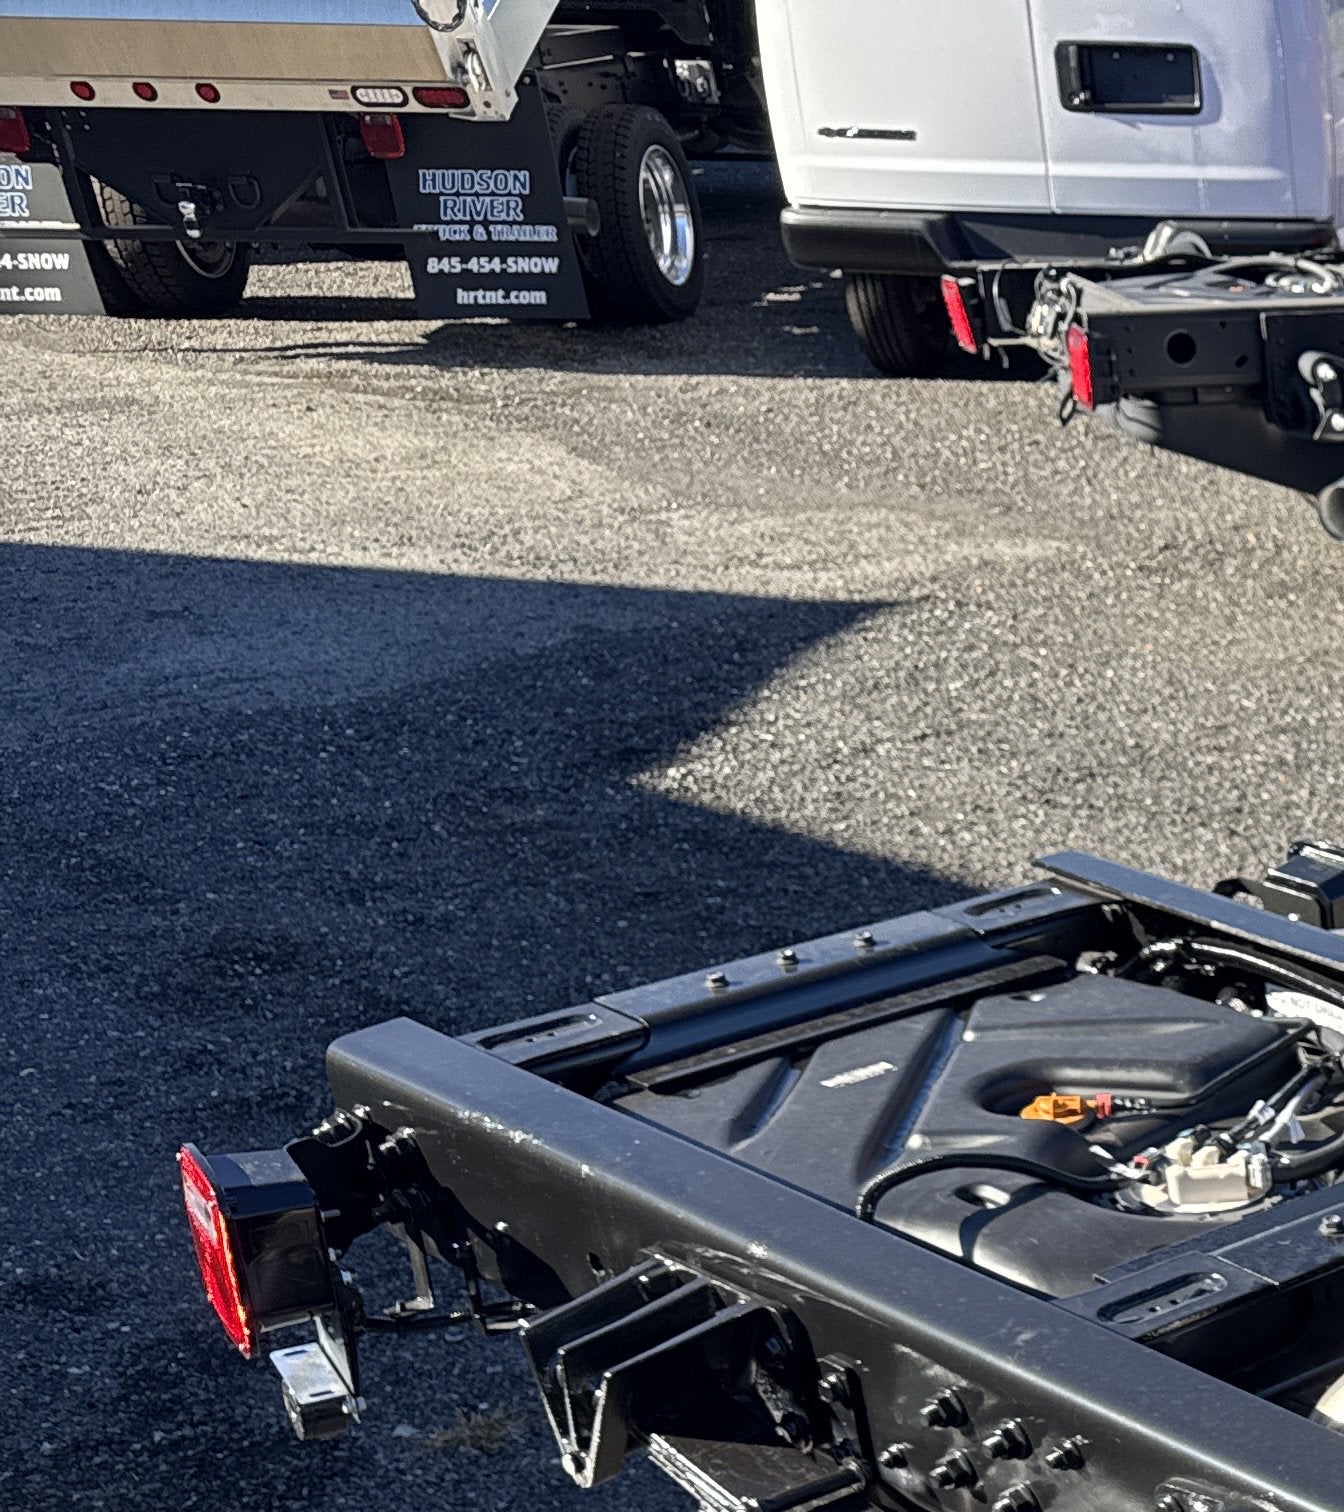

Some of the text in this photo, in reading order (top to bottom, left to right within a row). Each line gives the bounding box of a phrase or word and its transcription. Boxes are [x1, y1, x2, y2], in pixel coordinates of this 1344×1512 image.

[418, 168, 530, 195] HUDSON
[439, 196, 524, 221] RIVER
[473, 224, 488, 241] &
[489, 224, 558, 242] TRAILER
[0, 253, 70, 270] 4-SNOW
[426, 256, 560, 273] 845-454-SNOW
[456, 287, 548, 305] hrtnt.com
